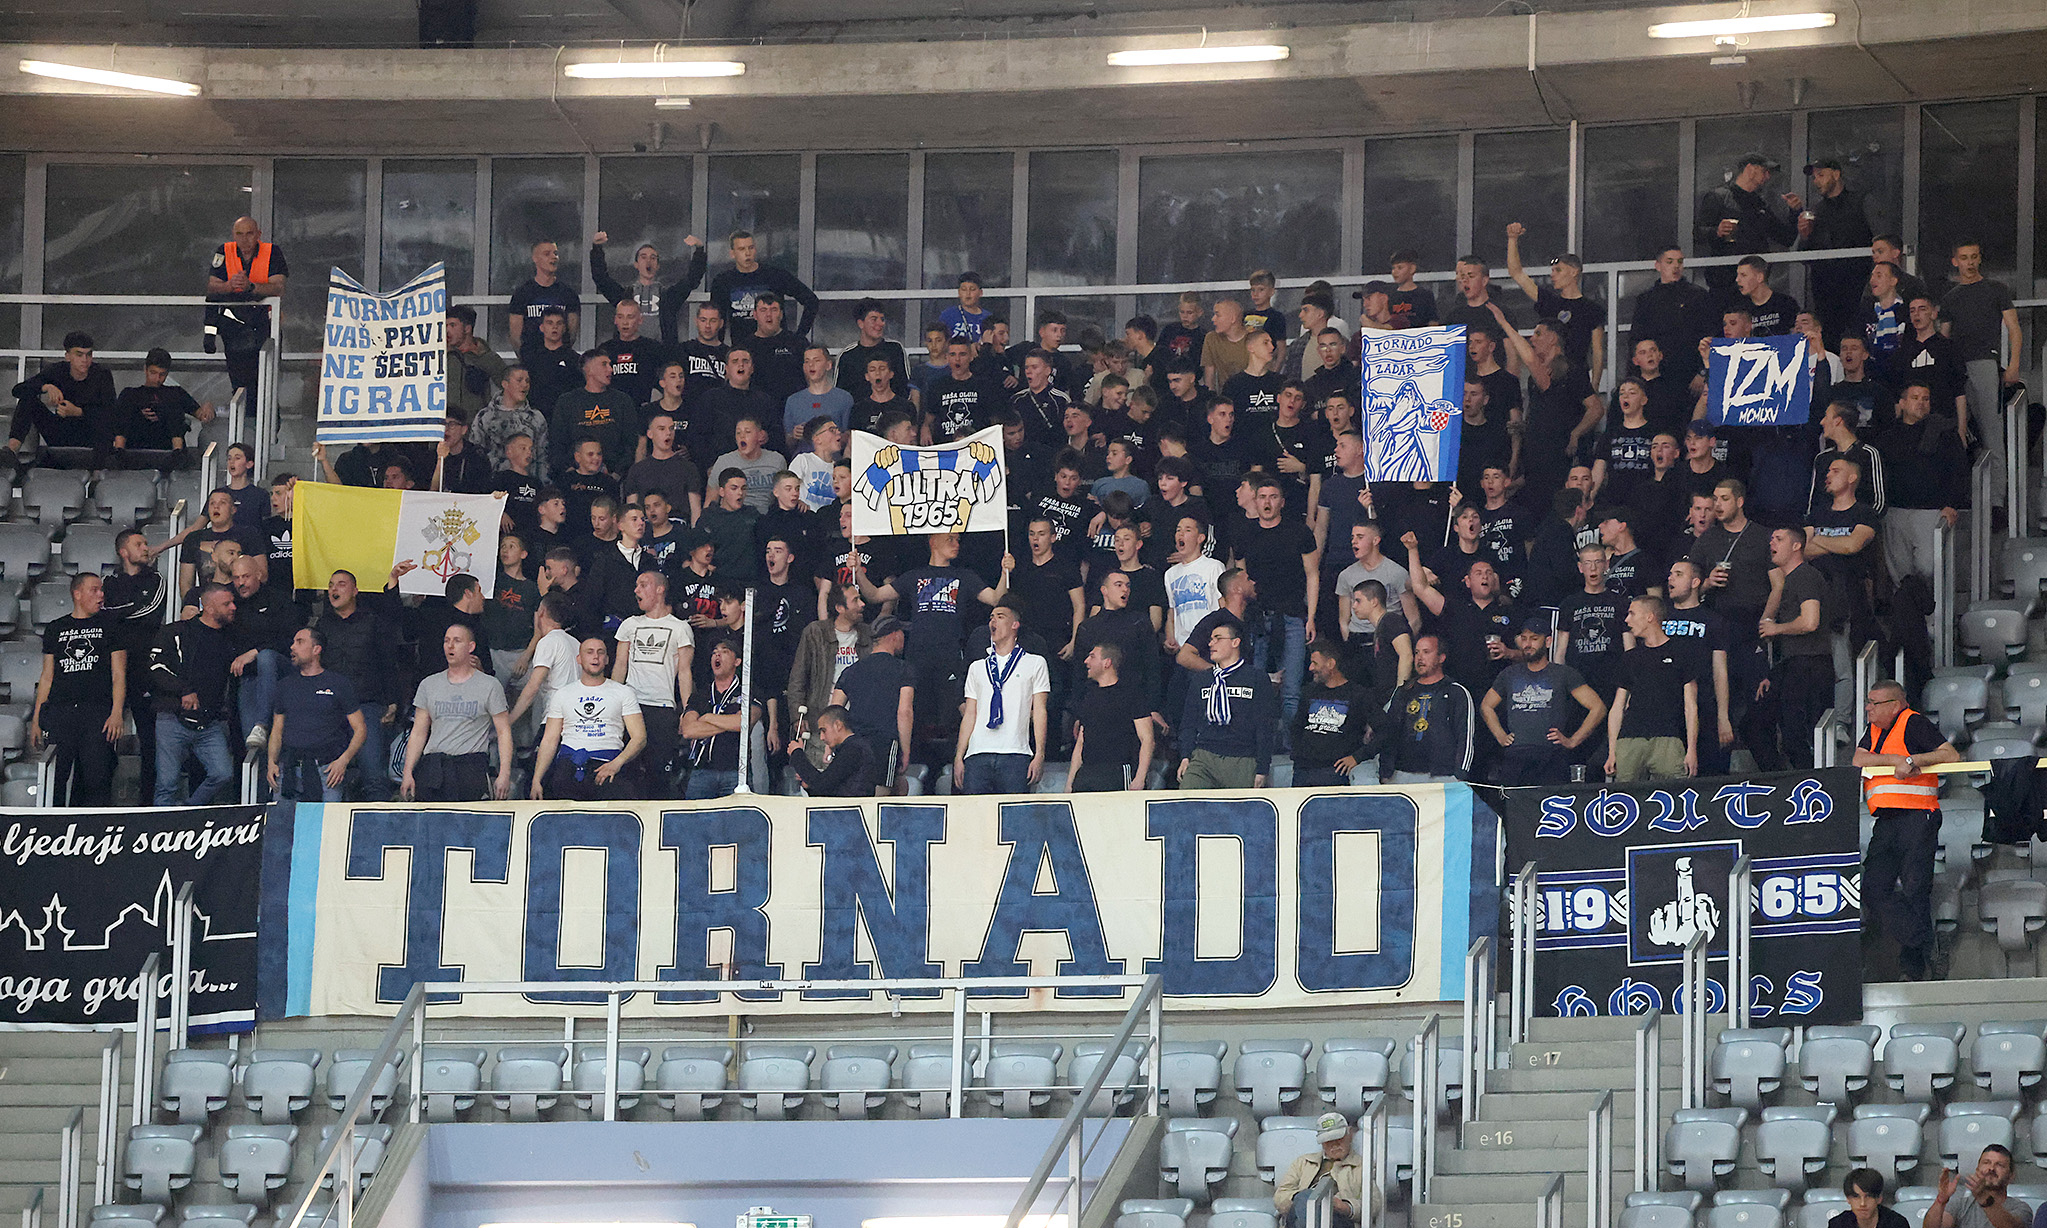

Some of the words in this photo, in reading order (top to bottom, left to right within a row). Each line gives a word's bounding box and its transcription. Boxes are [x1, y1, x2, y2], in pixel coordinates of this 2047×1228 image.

[328, 288, 446, 322] TORNADO
[326, 322, 371, 349] VAŠ
[384, 321, 444, 349] PRVI
[1375, 337, 1433, 352] TORNADO
[323, 353, 365, 380] NE
[374, 349, 444, 379] ŠESTI
[613, 362, 638, 376] DIESEL
[1376, 364, 1416, 375] ZADAR
[1710, 337, 1807, 423] TZM
[322, 376, 446, 415] IGRAČ
[1739, 403, 1779, 424] MCMLXV
[901, 501, 962, 528] 1965.
[270, 551, 292, 559] adida
[1535, 778, 1835, 839] SOUTH
[0, 822, 124, 866] ljednji
[132, 814, 263, 861] sanjari
[345, 793, 1420, 1005] TORNADO
[1543, 885, 1614, 934] 19
[1759, 872, 1842, 921] 65
